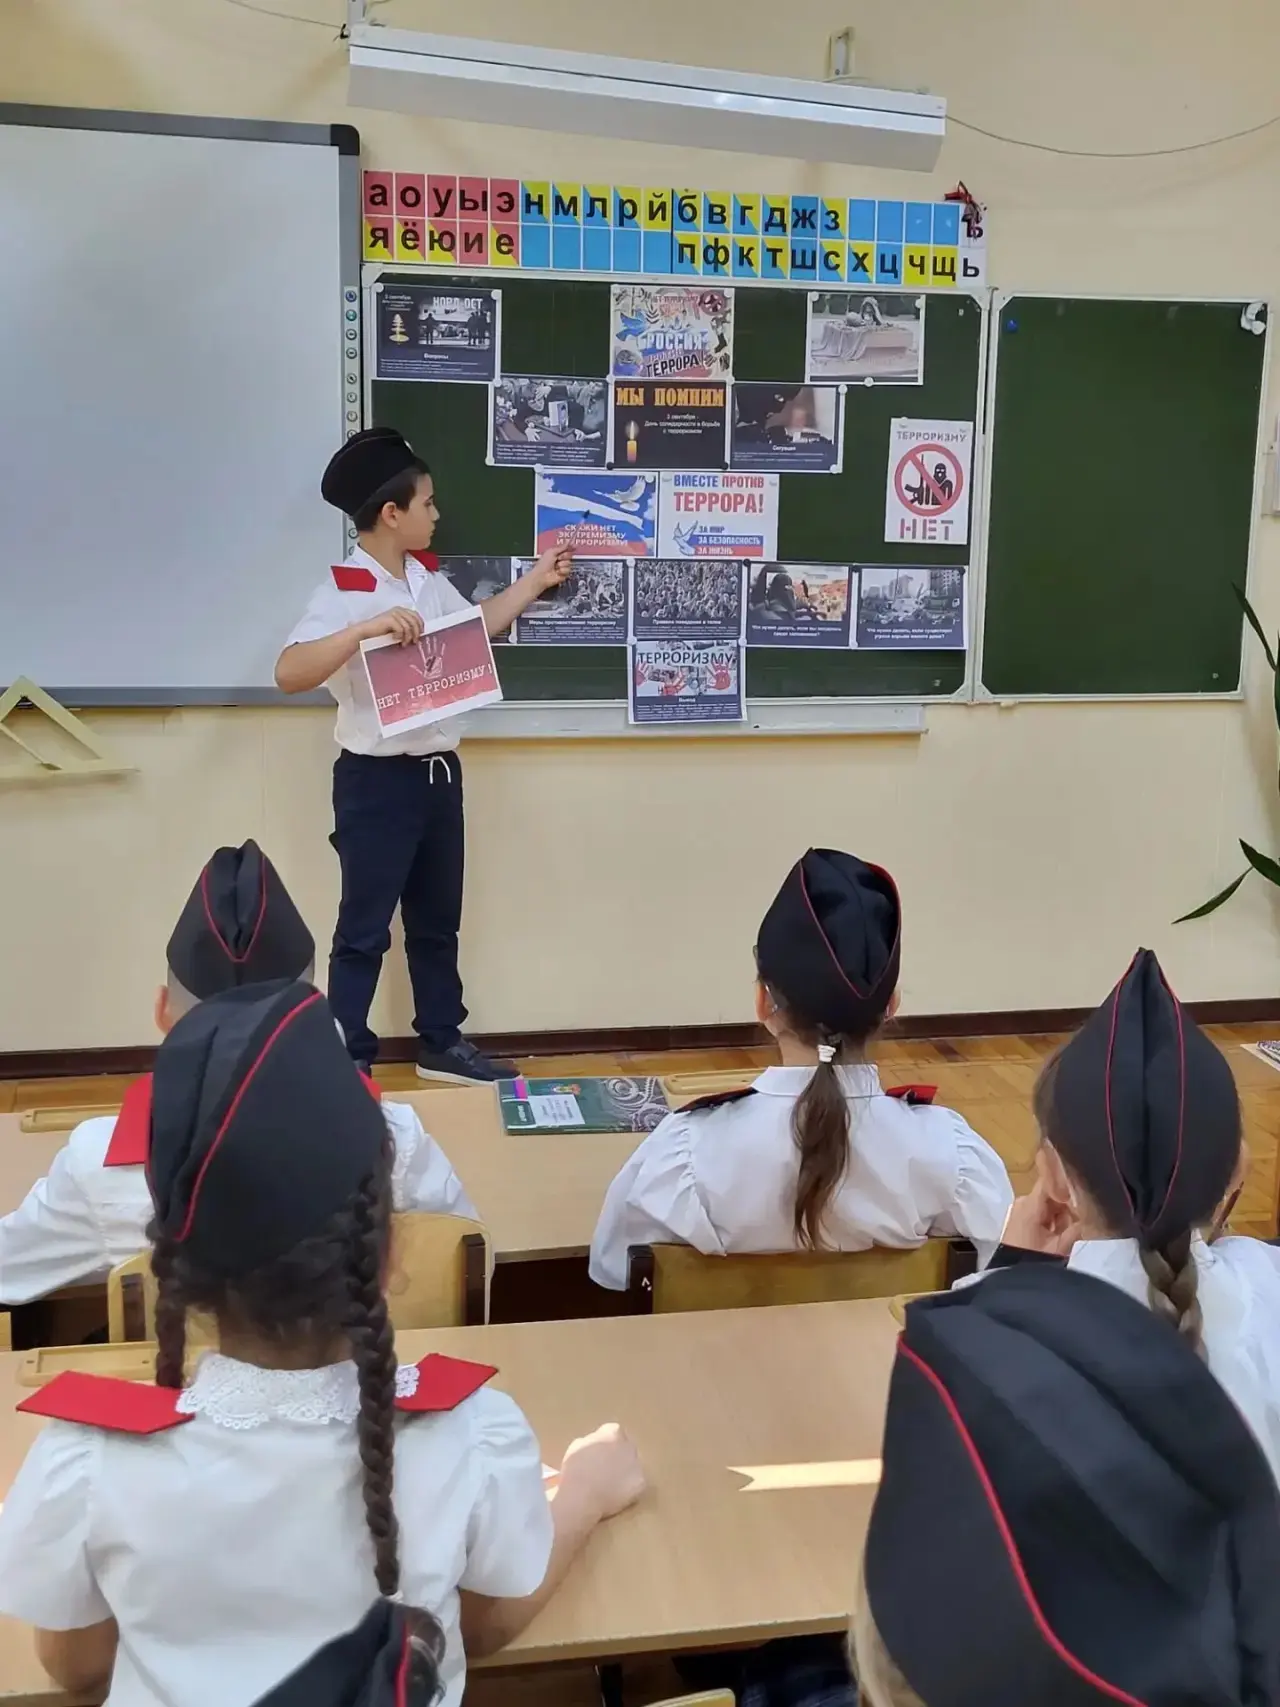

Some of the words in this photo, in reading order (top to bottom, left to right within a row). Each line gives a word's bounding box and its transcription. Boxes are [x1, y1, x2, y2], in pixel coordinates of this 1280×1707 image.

[369, 184, 388, 206] а
[400, 186, 421, 208] о
[434, 187, 452, 217] у
[460, 190, 487, 211] ы
[496, 191, 514, 212] э
[525, 193, 543, 214] н
[555, 195, 577, 216] м
[587, 197, 607, 217] л
[619, 198, 637, 226] р
[649, 193, 666, 221] й
[678, 193, 697, 222] б
[709, 205, 726, 224] в
[740, 206, 753, 225] г
[764, 207, 786, 232] д
[792, 209, 816, 228] ж
[825, 210, 839, 230] з
[370, 227, 388, 248] я
[402, 222, 419, 250] ё
[429, 230, 455, 252] ю
[465, 232, 482, 253] и
[496, 233, 514, 254] е
[679, 244, 695, 263] п
[703, 238, 729, 272] ф
[739, 246, 754, 266] к
[765, 248, 782, 267] т
[791, 249, 815, 270] ш
[824, 250, 840, 270] с
[852, 252, 869, 272] х
[880, 253, 897, 278] ц
[909, 254, 924, 274] ч
[933, 256, 956, 281] щ
[963, 258, 979, 278] ь
[647, 331, 702, 350] РОССИЯ
[616, 388, 644, 406] МЫ
[654, 388, 724, 407] ПОМНИМ
[897, 431, 967, 442] ТЕРРОРИЗМУ
[674, 475, 718, 487] ВМЕСТЕ
[722, 476, 764, 487] ПРОТИВ
[674, 492, 764, 513] ТЕРРОРА!
[900, 518, 953, 541] НЕТ
[709, 537, 760, 545] БЕЗОПАСНОСТЬ
[638, 652, 734, 664] ТЕРРОРИЗМУ
[378, 693, 400, 709] НЕТ
